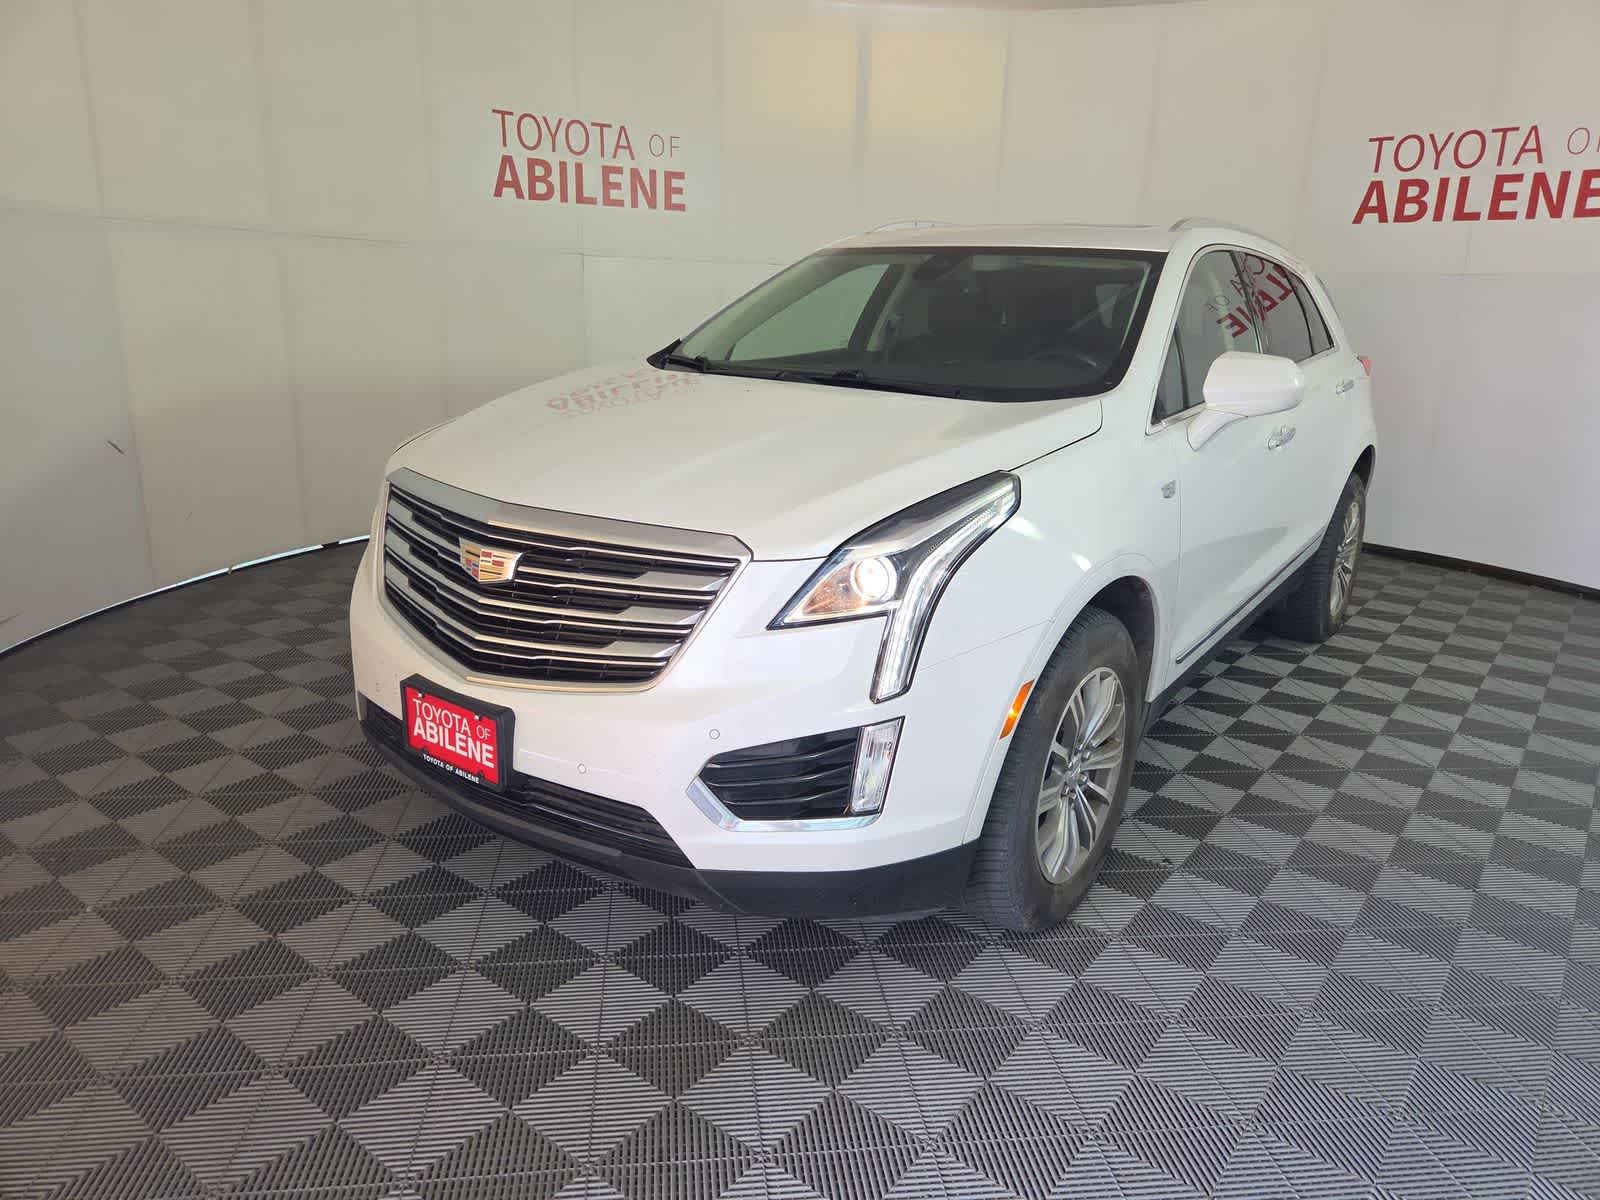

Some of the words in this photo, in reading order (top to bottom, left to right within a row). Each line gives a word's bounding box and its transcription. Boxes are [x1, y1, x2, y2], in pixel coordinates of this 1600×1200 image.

[491, 108, 636, 161] TOYOTA
[649, 133, 681, 158] OF
[1368, 124, 1544, 174] TOYOTA
[1567, 127, 1600, 156] O
[492, 154, 686, 212] ABILENE
[1352, 168, 1600, 225] ABILENE
[412, 698, 471, 737] TOYOTA
[476, 725, 492, 740] OF
[413, 717, 495, 769] ABILENE
[422, 753, 445, 769] TOYOTA
[445, 763, 454, 772] OF
[455, 767, 480, 784] ABILENE
